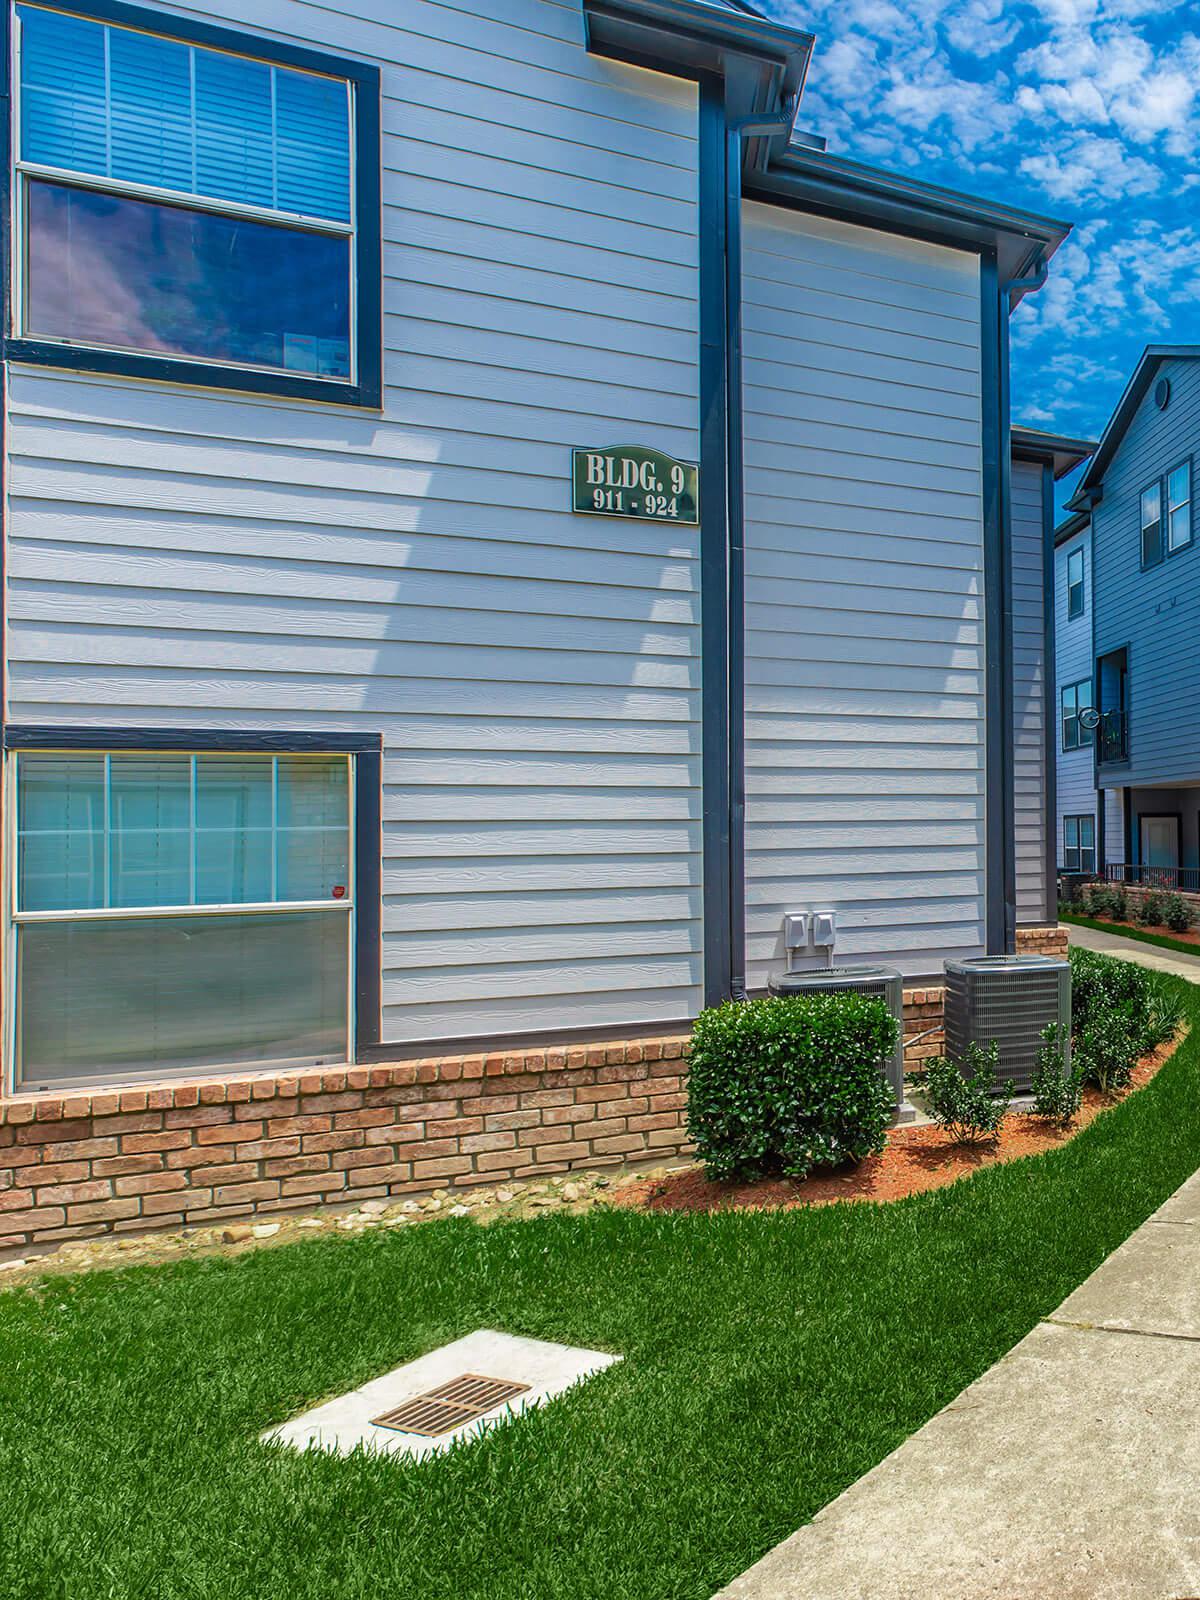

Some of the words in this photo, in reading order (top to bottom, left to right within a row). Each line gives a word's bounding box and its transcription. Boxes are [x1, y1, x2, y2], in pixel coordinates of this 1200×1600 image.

[586, 454, 663, 492] BLDG.
[671, 465, 684, 494] 9
[593, 488, 624, 511] 911
[645, 494, 679, 517] 924
